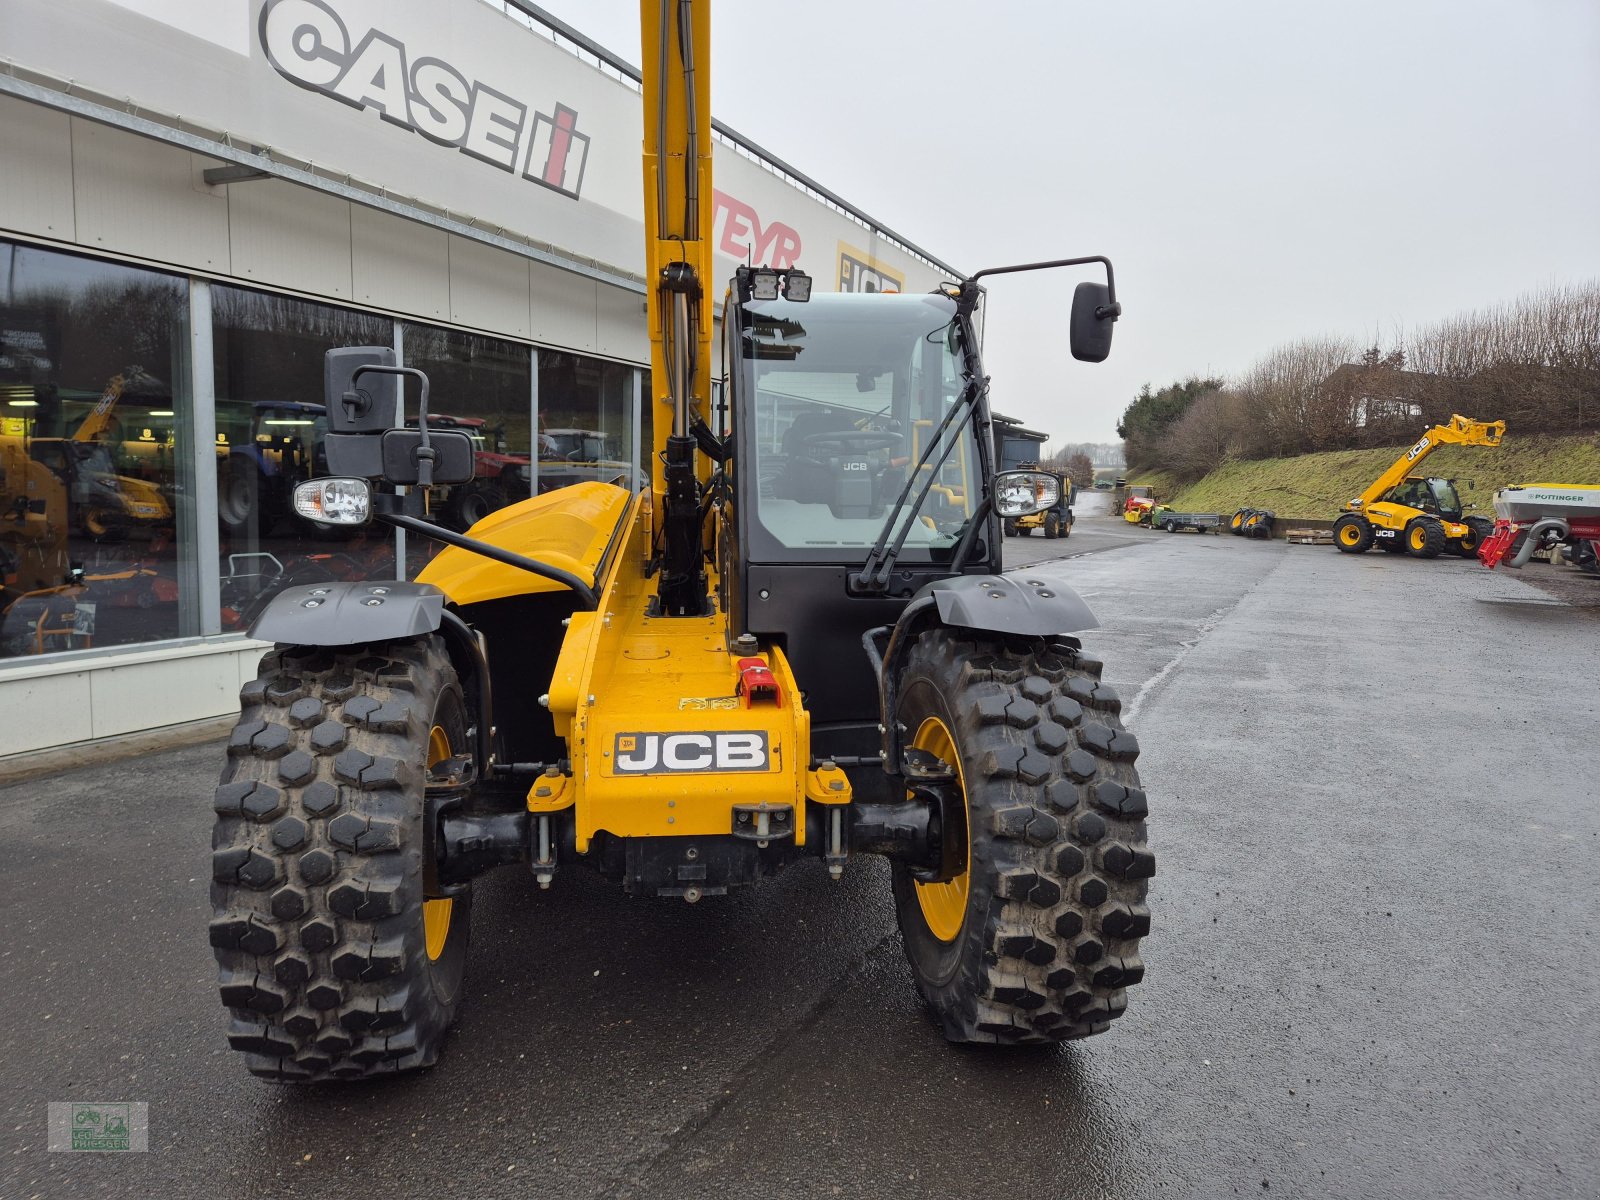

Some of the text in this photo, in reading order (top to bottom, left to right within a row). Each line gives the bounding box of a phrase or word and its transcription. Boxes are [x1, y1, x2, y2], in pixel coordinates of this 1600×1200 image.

[258, 0, 527, 174] CASE
[1407, 437, 1429, 461] JCB
[843, 462, 867, 471] JCB
[1375, 530, 1395, 538] JCB
[617, 734, 765, 770] JCB
